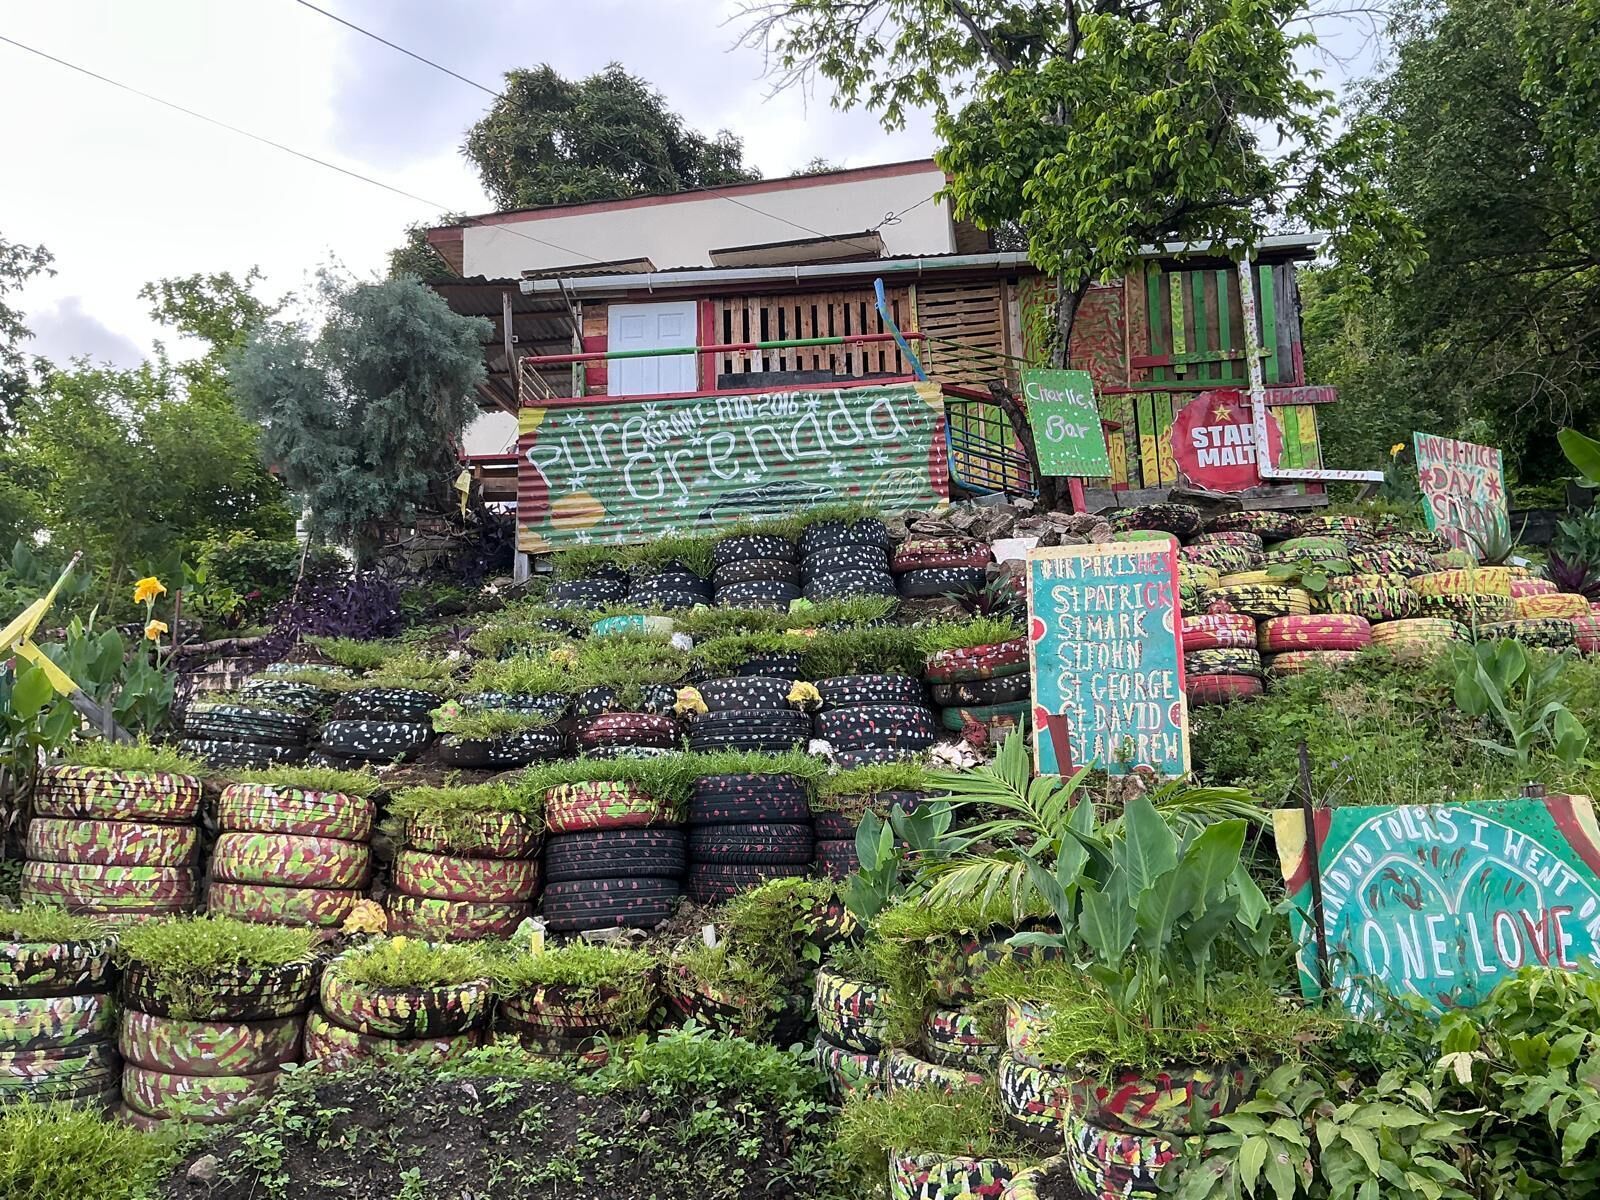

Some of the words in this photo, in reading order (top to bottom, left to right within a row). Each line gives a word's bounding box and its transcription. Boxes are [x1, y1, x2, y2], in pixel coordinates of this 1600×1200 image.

[1045, 415, 1090, 443] Bar
[1191, 424, 1256, 448] STAR
[1197, 446, 1256, 468] MALT
[1418, 437, 1452, 464] HAVE
[1463, 443, 1500, 471] NICE
[1432, 466, 1476, 493] DAY
[1040, 557, 1076, 580] OUR
[1080, 551, 1172, 578] PARISHES
[1084, 580, 1173, 611] PATRICK
[1086, 610, 1149, 640] MARK
[1082, 640, 1142, 672] JOHN
[1090, 669, 1174, 701] GEORGE
[1093, 700, 1161, 732] DAVID
[1093, 730, 1179, 764] ANDREW
[1471, 818, 1489, 850] I
[1503, 828, 1578, 896] WENT
[1362, 913, 1455, 981] ONE
[1467, 904, 1580, 971] LOVE
